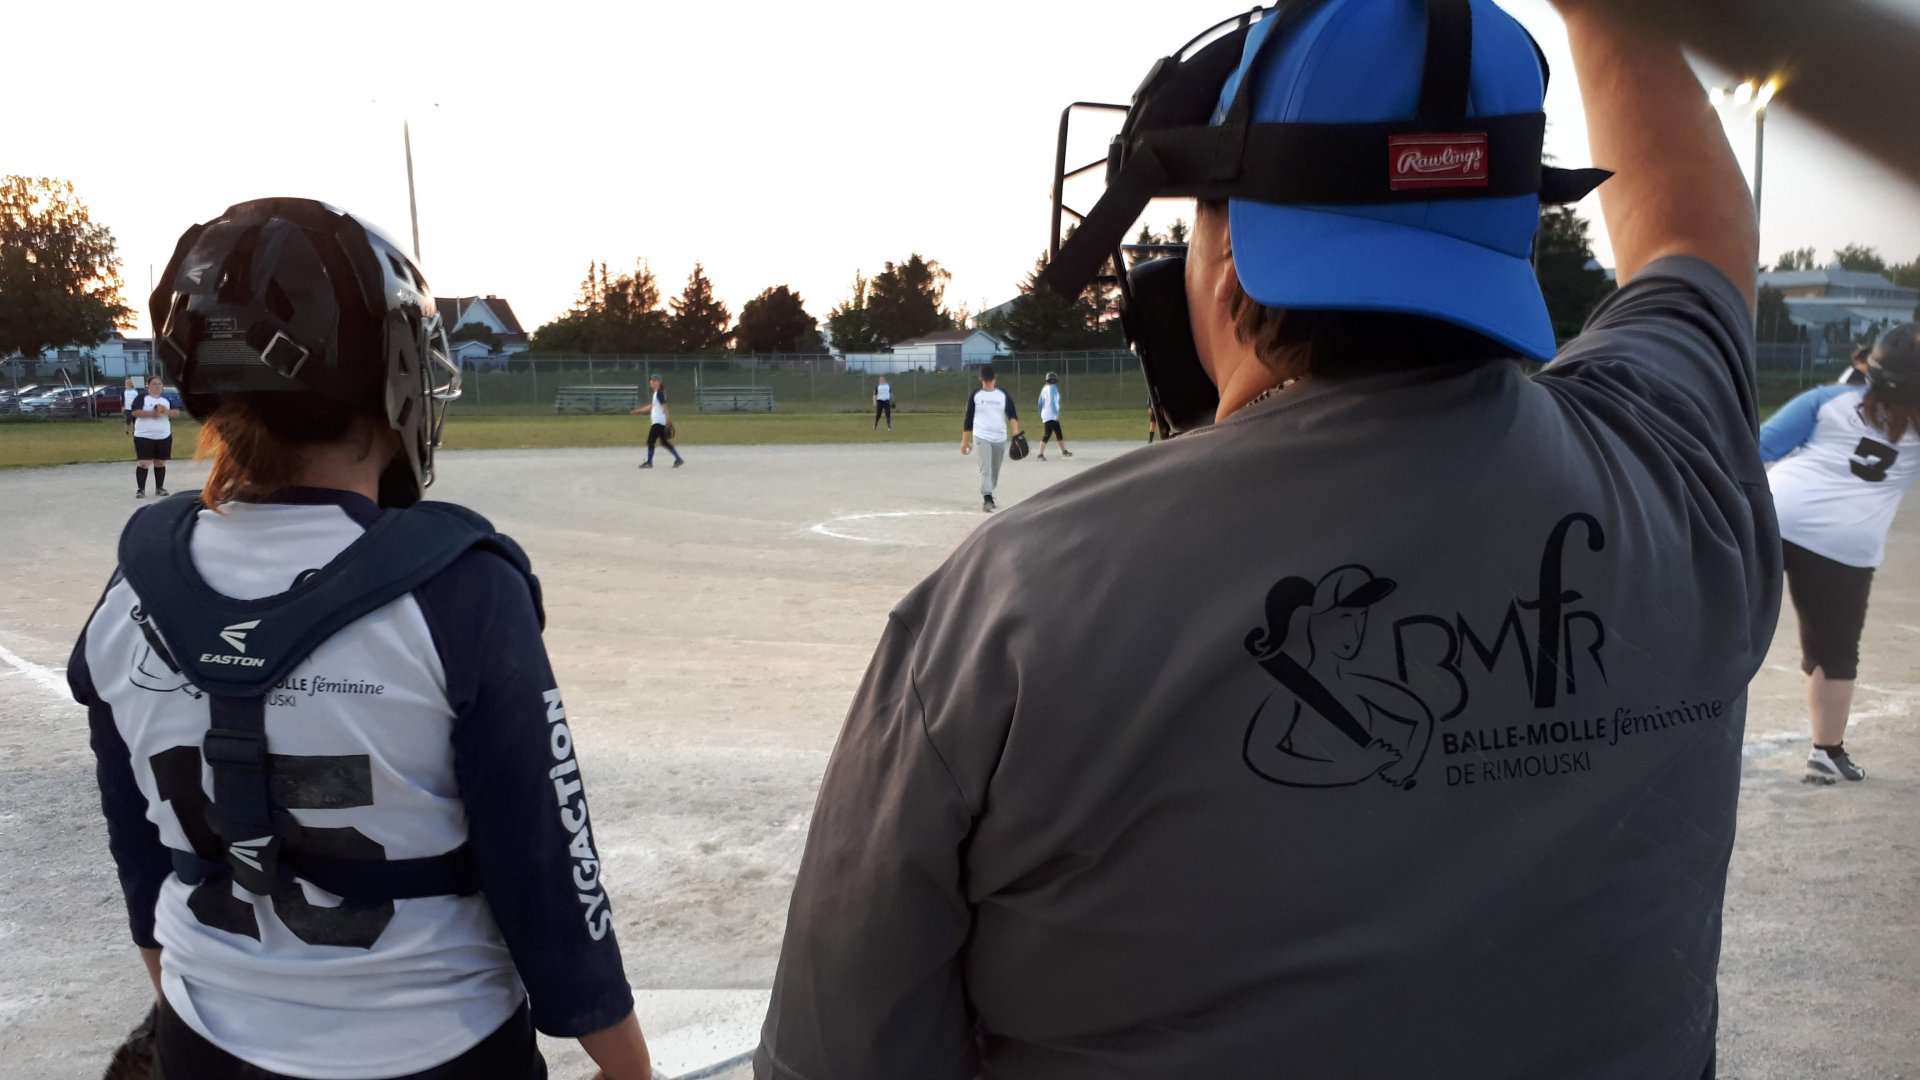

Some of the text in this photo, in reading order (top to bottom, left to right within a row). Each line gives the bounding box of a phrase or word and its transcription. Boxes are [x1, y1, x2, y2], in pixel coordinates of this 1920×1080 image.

[1397, 145, 1484, 174] Rawlings
[200, 653, 266, 668] EASTON
[265, 694, 296, 707] USKI
[308, 675, 385, 697] féminine
[1442, 699, 1723, 756] BALLE-MOLLE féminine
[1446, 751, 1592, 786] DE RIMOUSKI
[542, 687, 613, 941] SYGACTION
